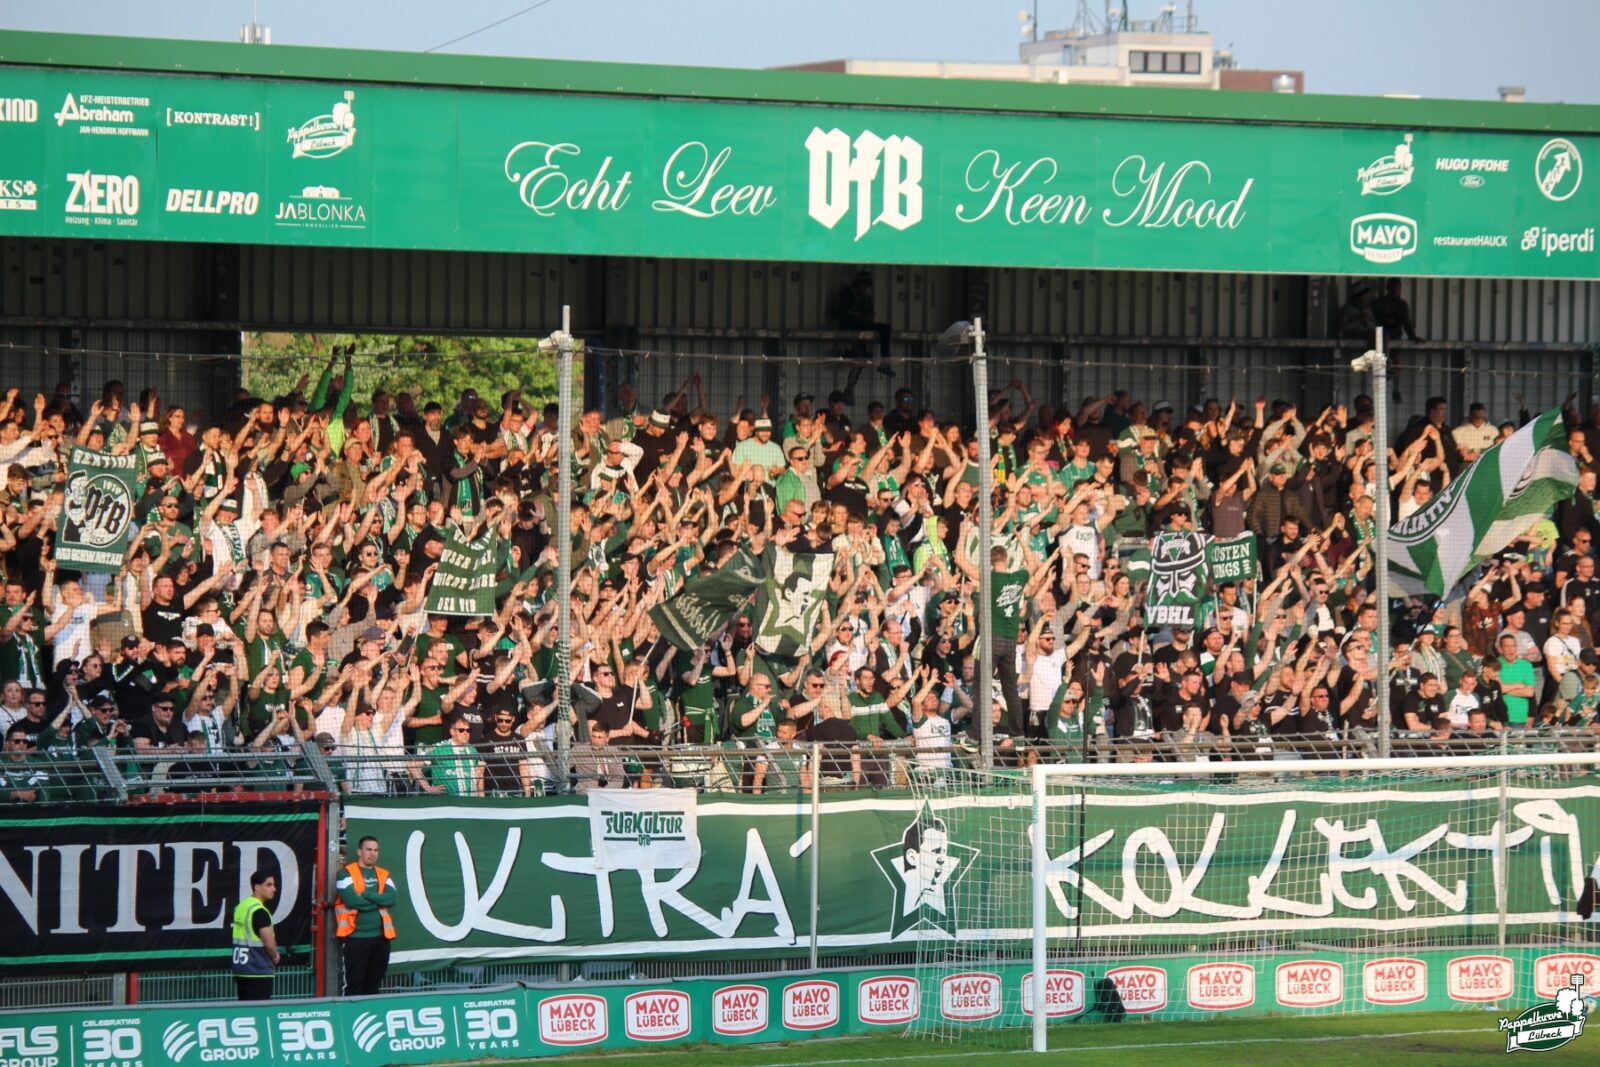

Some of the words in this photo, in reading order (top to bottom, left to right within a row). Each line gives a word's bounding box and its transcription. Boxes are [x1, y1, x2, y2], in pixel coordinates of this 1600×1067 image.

[80, 95, 150, 106] KFZ-MEISTERBETRIEB
[54, 92, 134, 127] Abraham
[80, 126, 117, 135] JAN-HENDRIK
[118, 127, 149, 136] HOFFMANN
[1435, 158, 1469, 171] HUGO
[1470, 158, 1510, 172] PFOHE
[504, 141, 632, 217] Echt
[652, 141, 777, 218] Leev
[955, 150, 1093, 226] Keen
[1102, 154, 1255, 229] Mood
[165, 188, 260, 215] DELLPRO
[275, 202, 367, 222] JABLONKA
[65, 216, 90, 226] Heizung
[94, 217, 112, 226] Klima
[1356, 224, 1412, 246] MAYO
[1541, 227, 1596, 257] iperdi
[1145, 605, 1195, 625] VBHL
[1287, 968, 1331, 982] MAYO
[1375, 966, 1416, 980] MAYO
[1459, 962, 1502, 978] MAYO
[1547, 961, 1594, 975] MAYO
[1045, 977, 1074, 992] AYO
[1115, 974, 1157, 988] MAYO
[1199, 970, 1243, 985] MAYO
[1459, 977, 1502, 989] LÜBECK
[1547, 975, 1593, 988] LÜBK
[869, 984, 909, 999] MAYO
[951, 980, 991, 995] MAYO
[1199, 985, 1243, 997] LÜBECK
[1287, 983, 1331, 995] LÜBECK
[1375, 980, 1415, 992] LÜBECK
[722, 993, 759, 1009] MAYO
[792, 988, 830, 1004] MAYO
[951, 995, 991, 1008] LÜBECK
[1045, 992, 1074, 1004] BECK
[1120, 989, 1157, 1001] ÜBECK
[464, 999, 516, 1008] CELEBRATING
[636, 998, 680, 1014] MAYO
[792, 1004, 829, 1017] LÜBECK
[869, 999, 909, 1012] LÜBECK
[277, 1011, 331, 1019] CELEBRATING
[550, 1003, 596, 1019] MAYO
[722, 1009, 758, 1022] LÜBECK
[82, 1018, 141, 1027] CELEBRATING
[386, 1007, 444, 1037] FLS
[465, 1008, 517, 1040] 30
[551, 1020, 596, 1032] LÜBECK
[636, 1014, 679, 1027] LÜBECK
[198, 1017, 258, 1047] FLS
[279, 1020, 334, 1051] 30
[0, 1026, 58, 1056] FLS
[83, 1028, 141, 1060] 30
[389, 1037, 446, 1051] GROUP
[469, 1040, 519, 1050] YEARS
[201, 1047, 259, 1061] GROUP
[283, 1051, 336, 1062] YEARS
[0, 1056, 59, 1067] GROUP
